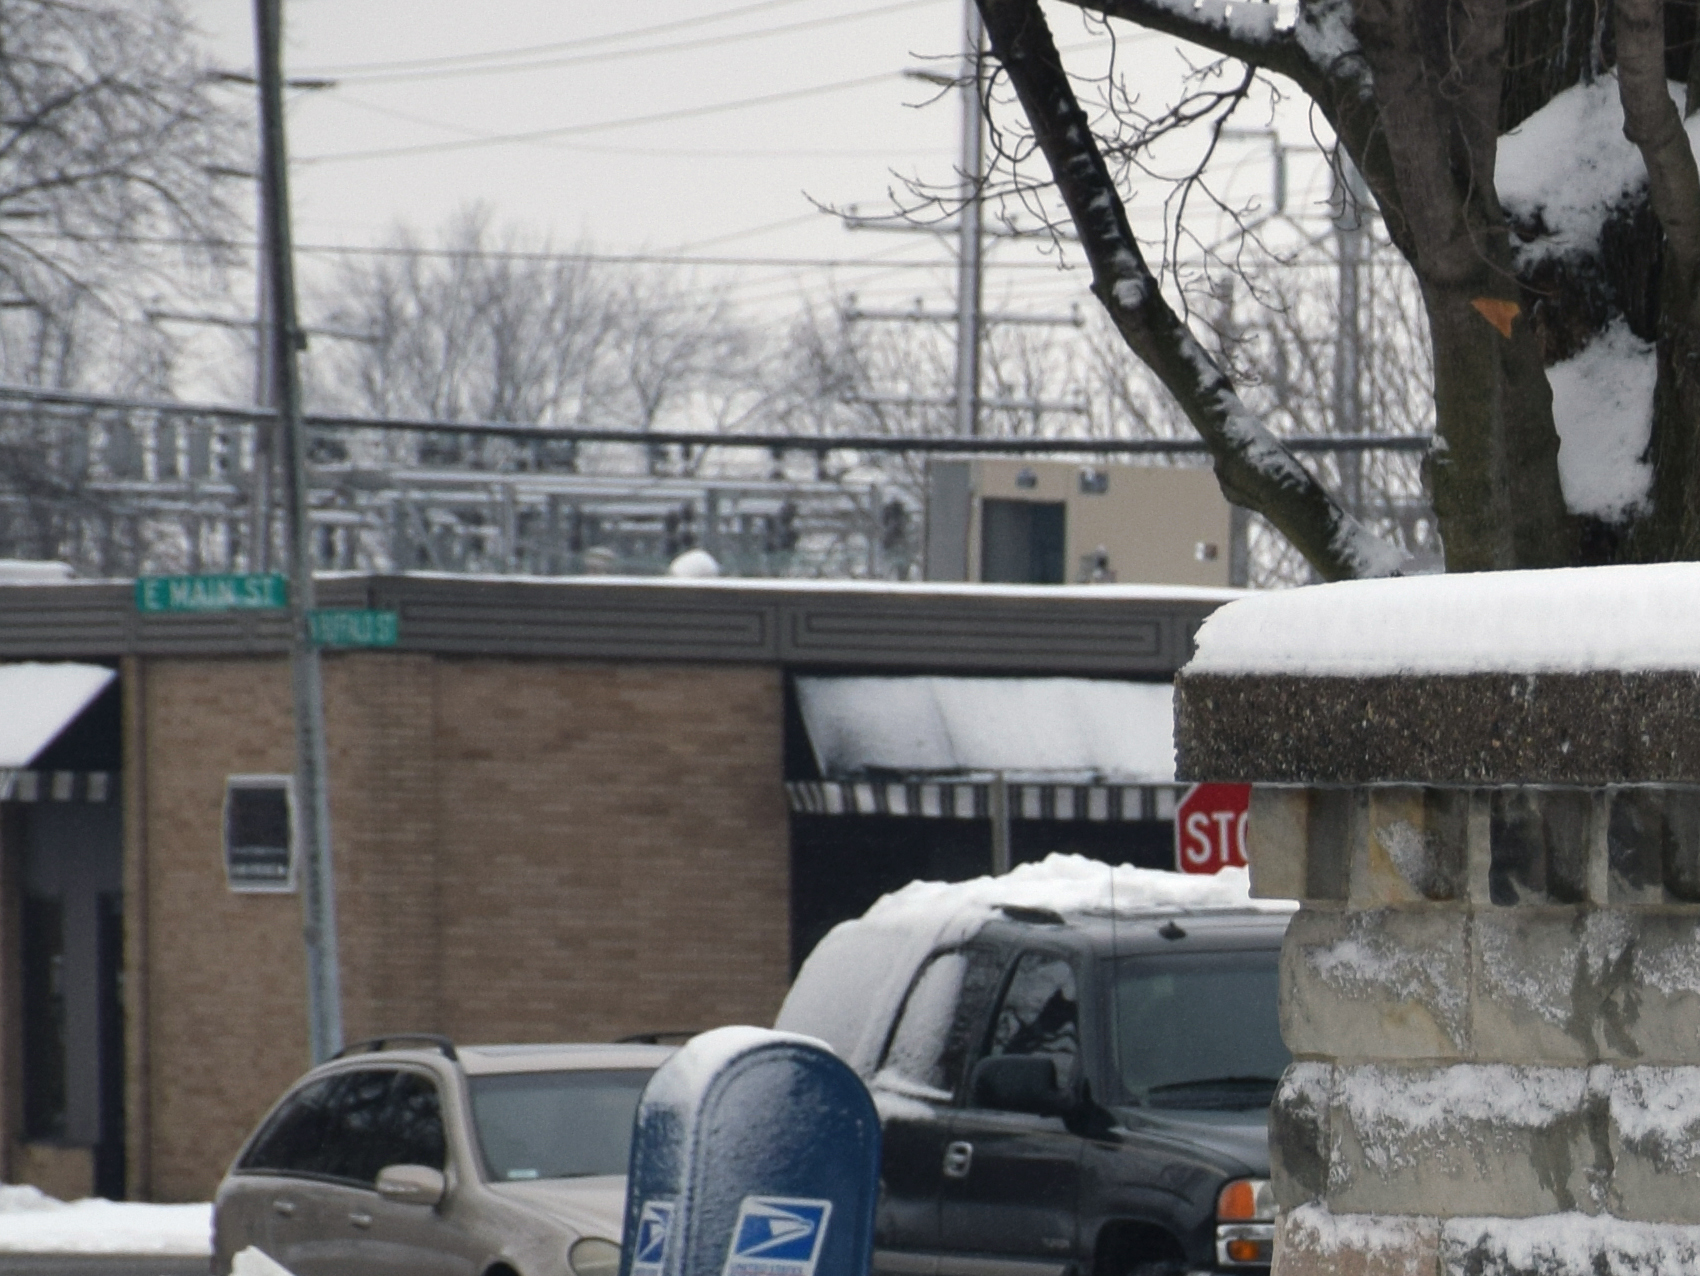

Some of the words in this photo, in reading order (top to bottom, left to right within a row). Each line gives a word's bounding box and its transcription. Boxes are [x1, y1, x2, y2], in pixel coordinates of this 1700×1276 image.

[144, 580, 160, 610] E
[169, 579, 235, 609] MAIN
[245, 578, 275, 606] ST
